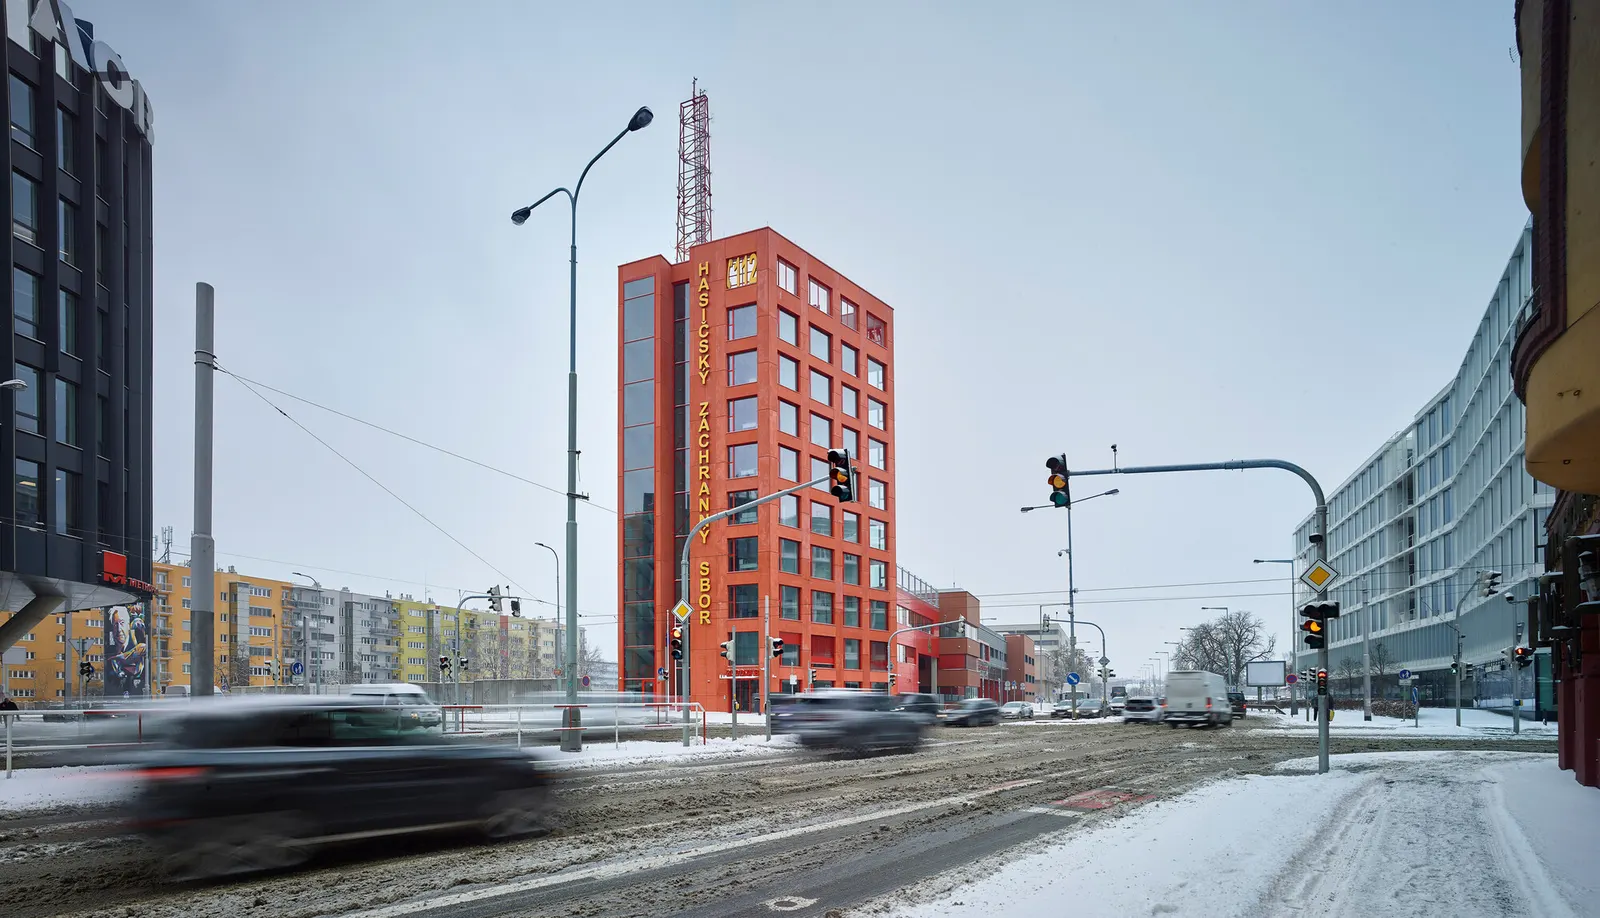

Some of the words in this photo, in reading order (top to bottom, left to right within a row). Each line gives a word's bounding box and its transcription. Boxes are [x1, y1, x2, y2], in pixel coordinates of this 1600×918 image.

[733, 252, 758, 287] 112
[697, 261, 710, 386] HASIČSKÝ
[698, 561, 712, 625] SBOR
